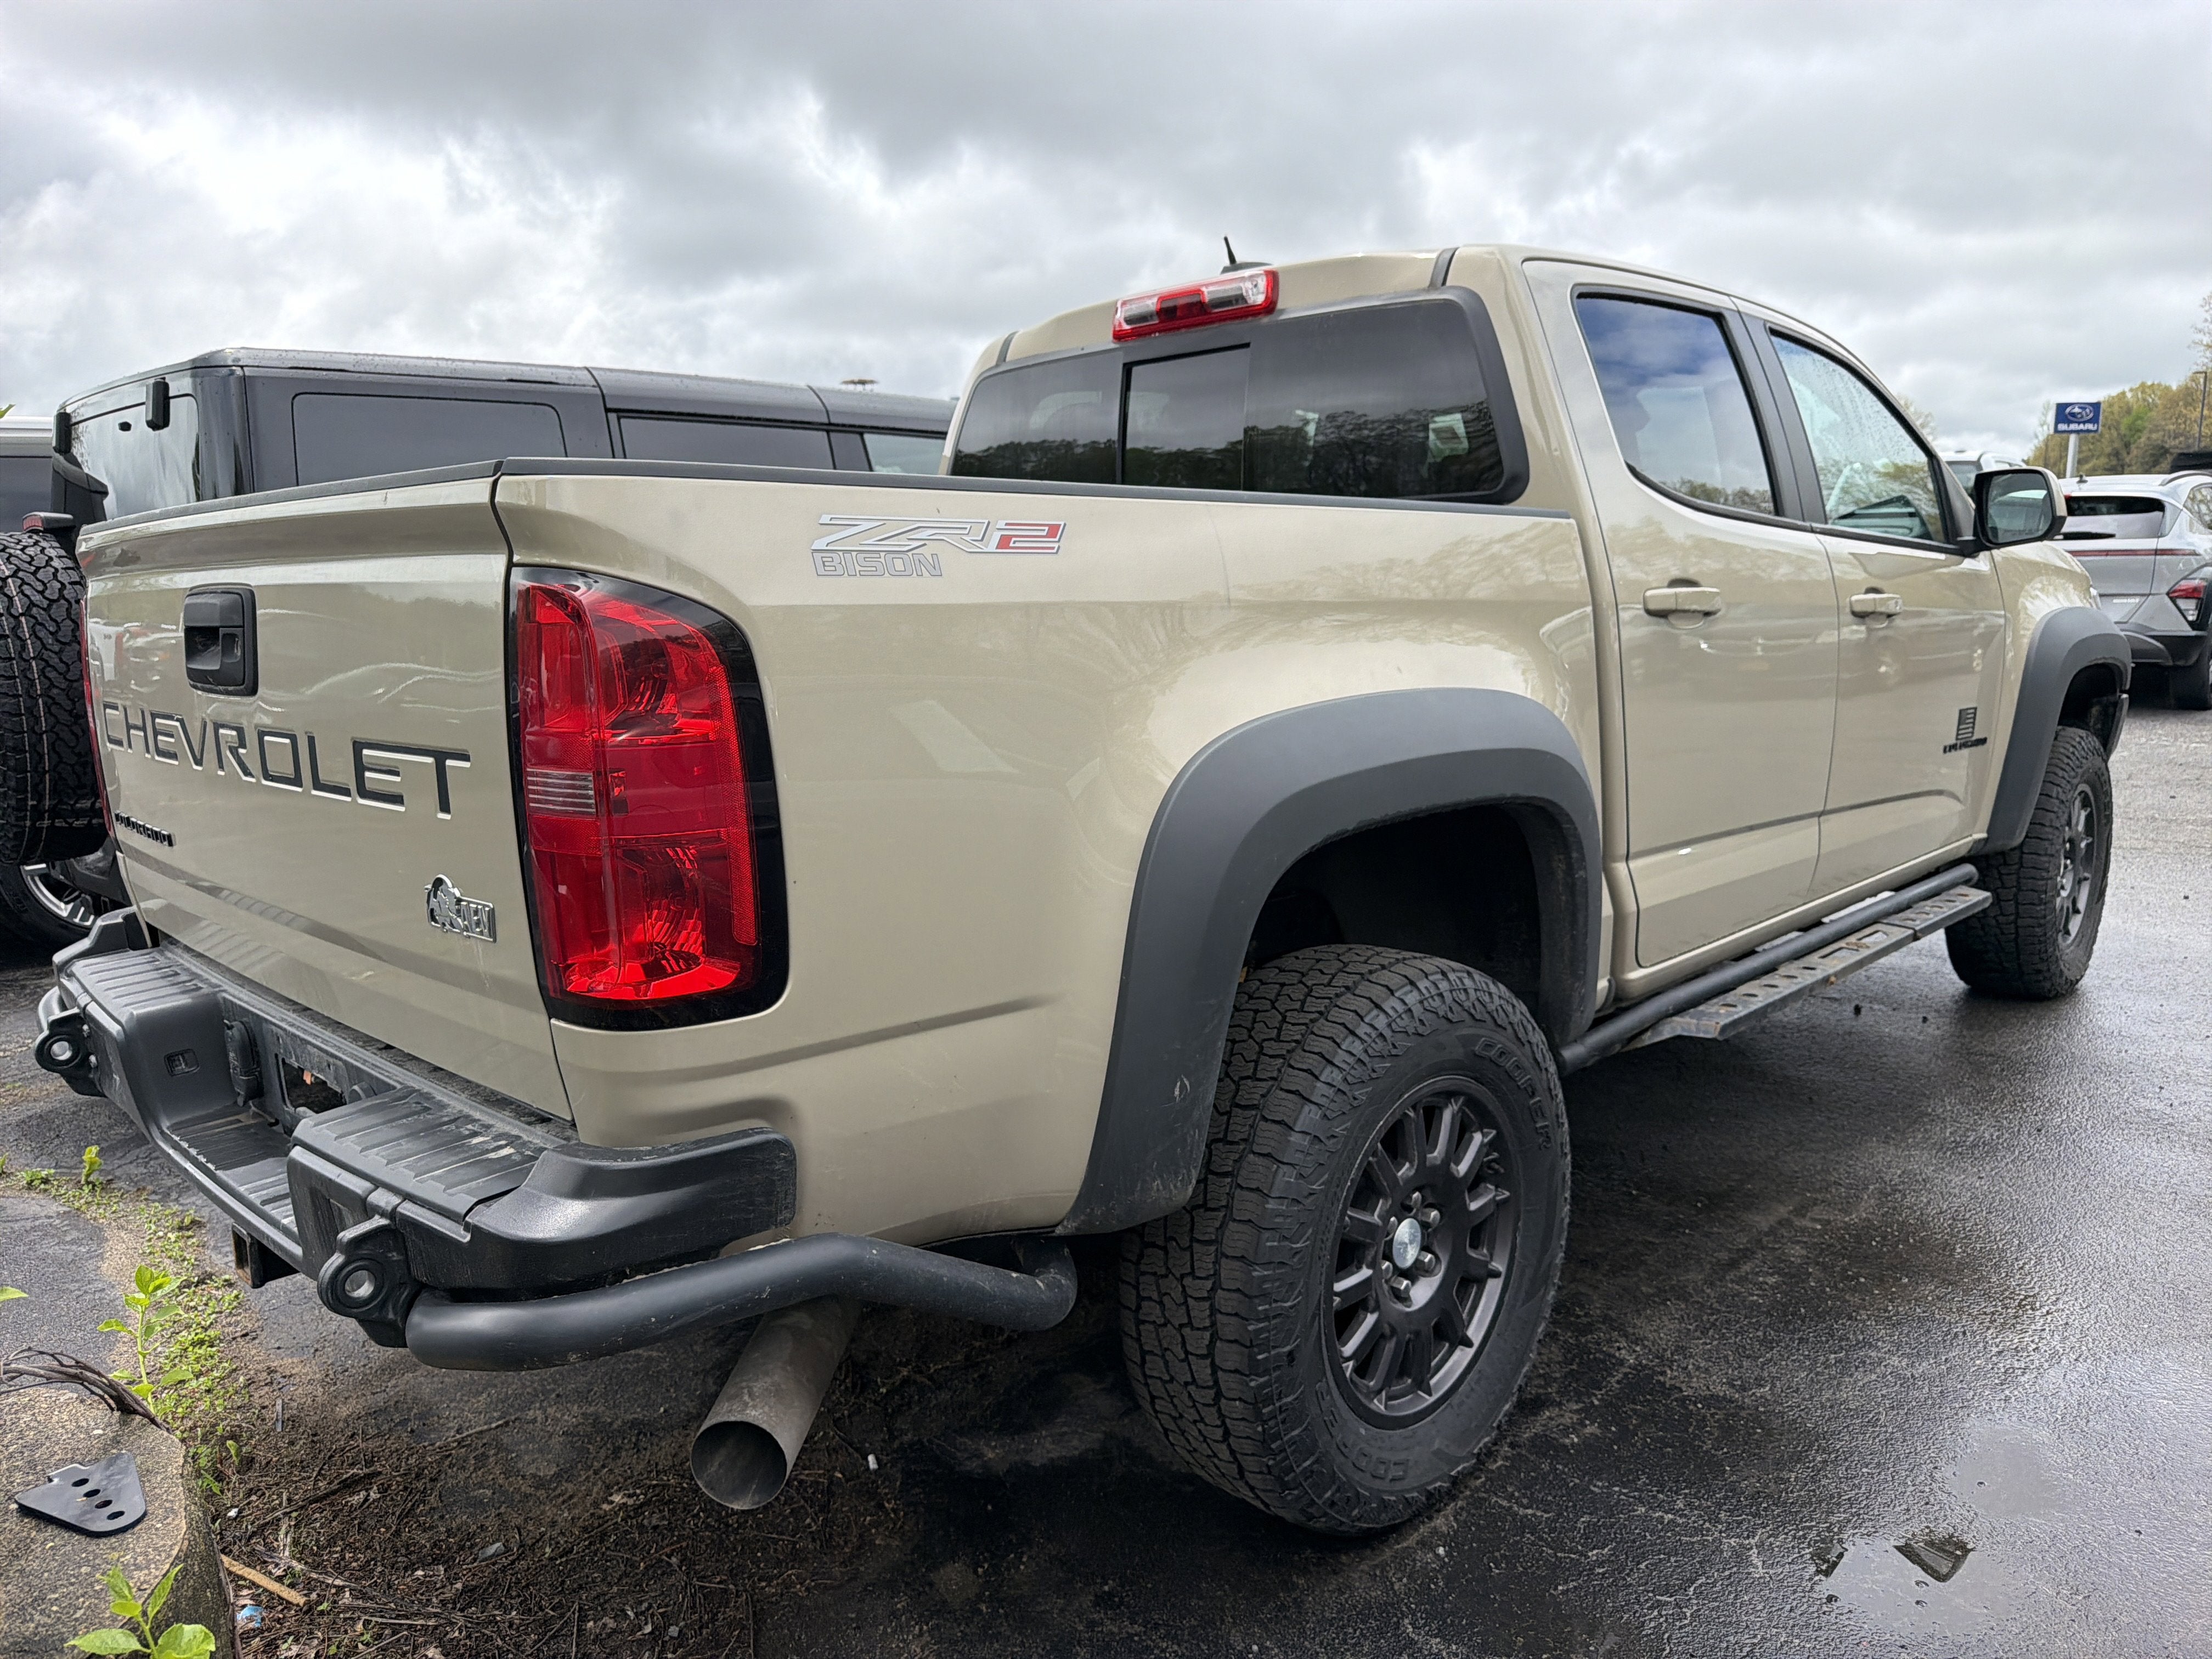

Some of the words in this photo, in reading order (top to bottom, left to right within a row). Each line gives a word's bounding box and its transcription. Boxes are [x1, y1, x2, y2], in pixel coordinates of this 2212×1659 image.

[811, 514, 1066, 554] ZR2
[811, 552, 943, 577] BISON
[103, 701, 471, 820] CHEVROLET
[1475, 1037, 1552, 1151] COOPER
